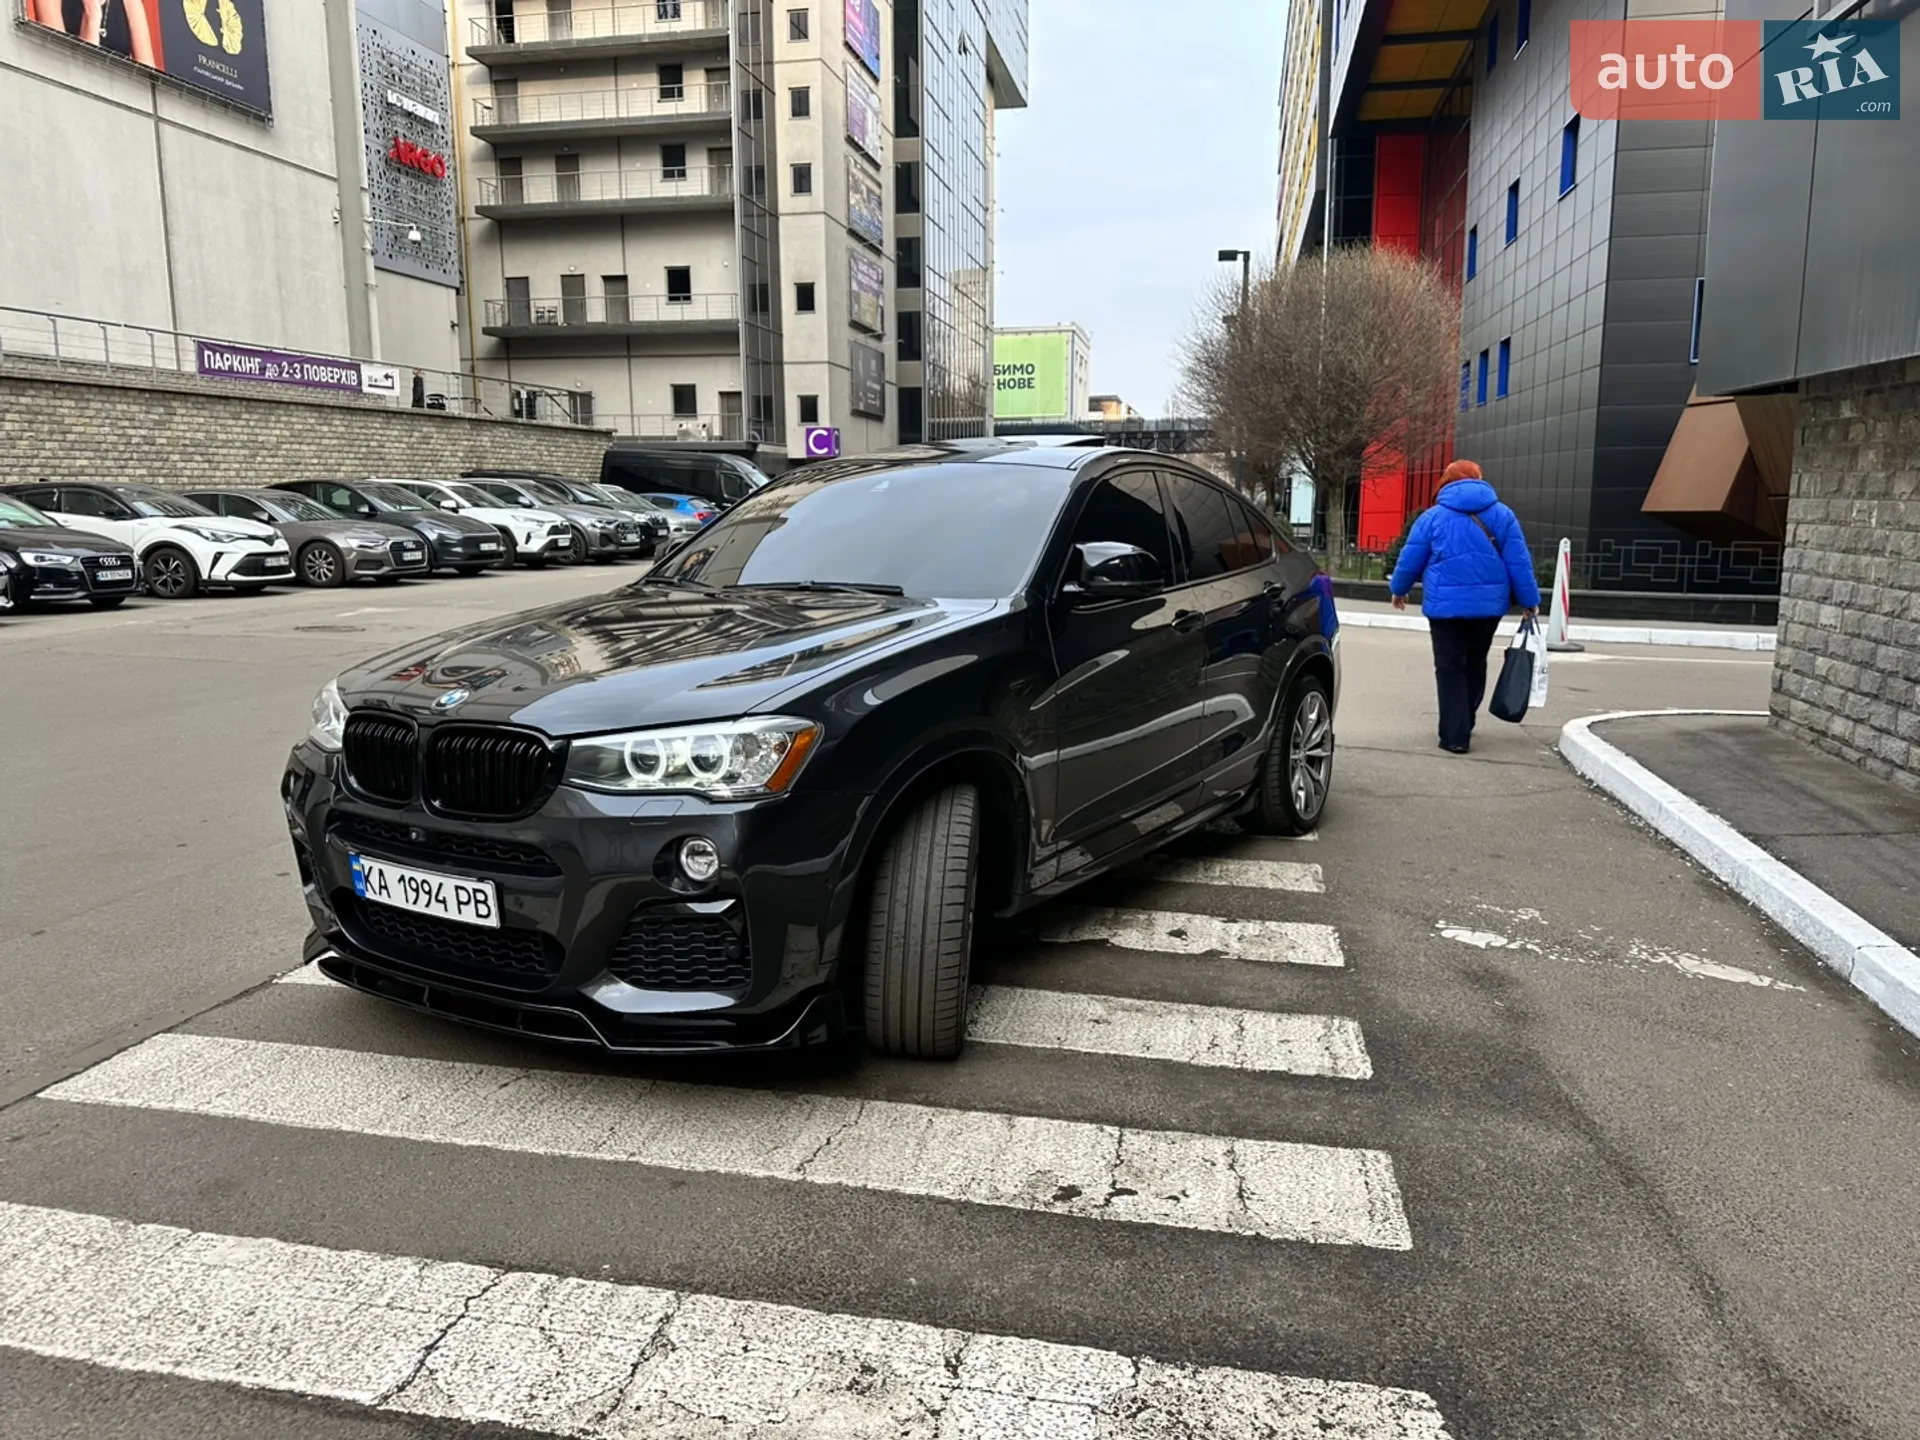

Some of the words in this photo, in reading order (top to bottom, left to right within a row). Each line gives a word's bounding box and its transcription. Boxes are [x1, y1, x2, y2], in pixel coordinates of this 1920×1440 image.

[197, 54, 238, 79] FRANCELLI
[388, 136, 446, 181] ARGO
[204, 350, 262, 375] ПАРКІНГ
[281, 361, 301, 379] 2-3
[303, 364, 358, 386] ПОВЕРХІВ
[997, 377, 1035, 390] НОВЕ
[808, 429, 829, 454] C
[362, 863, 391, 898] KA
[398, 874, 448, 912] 1994
[455, 885, 491, 919] PB
